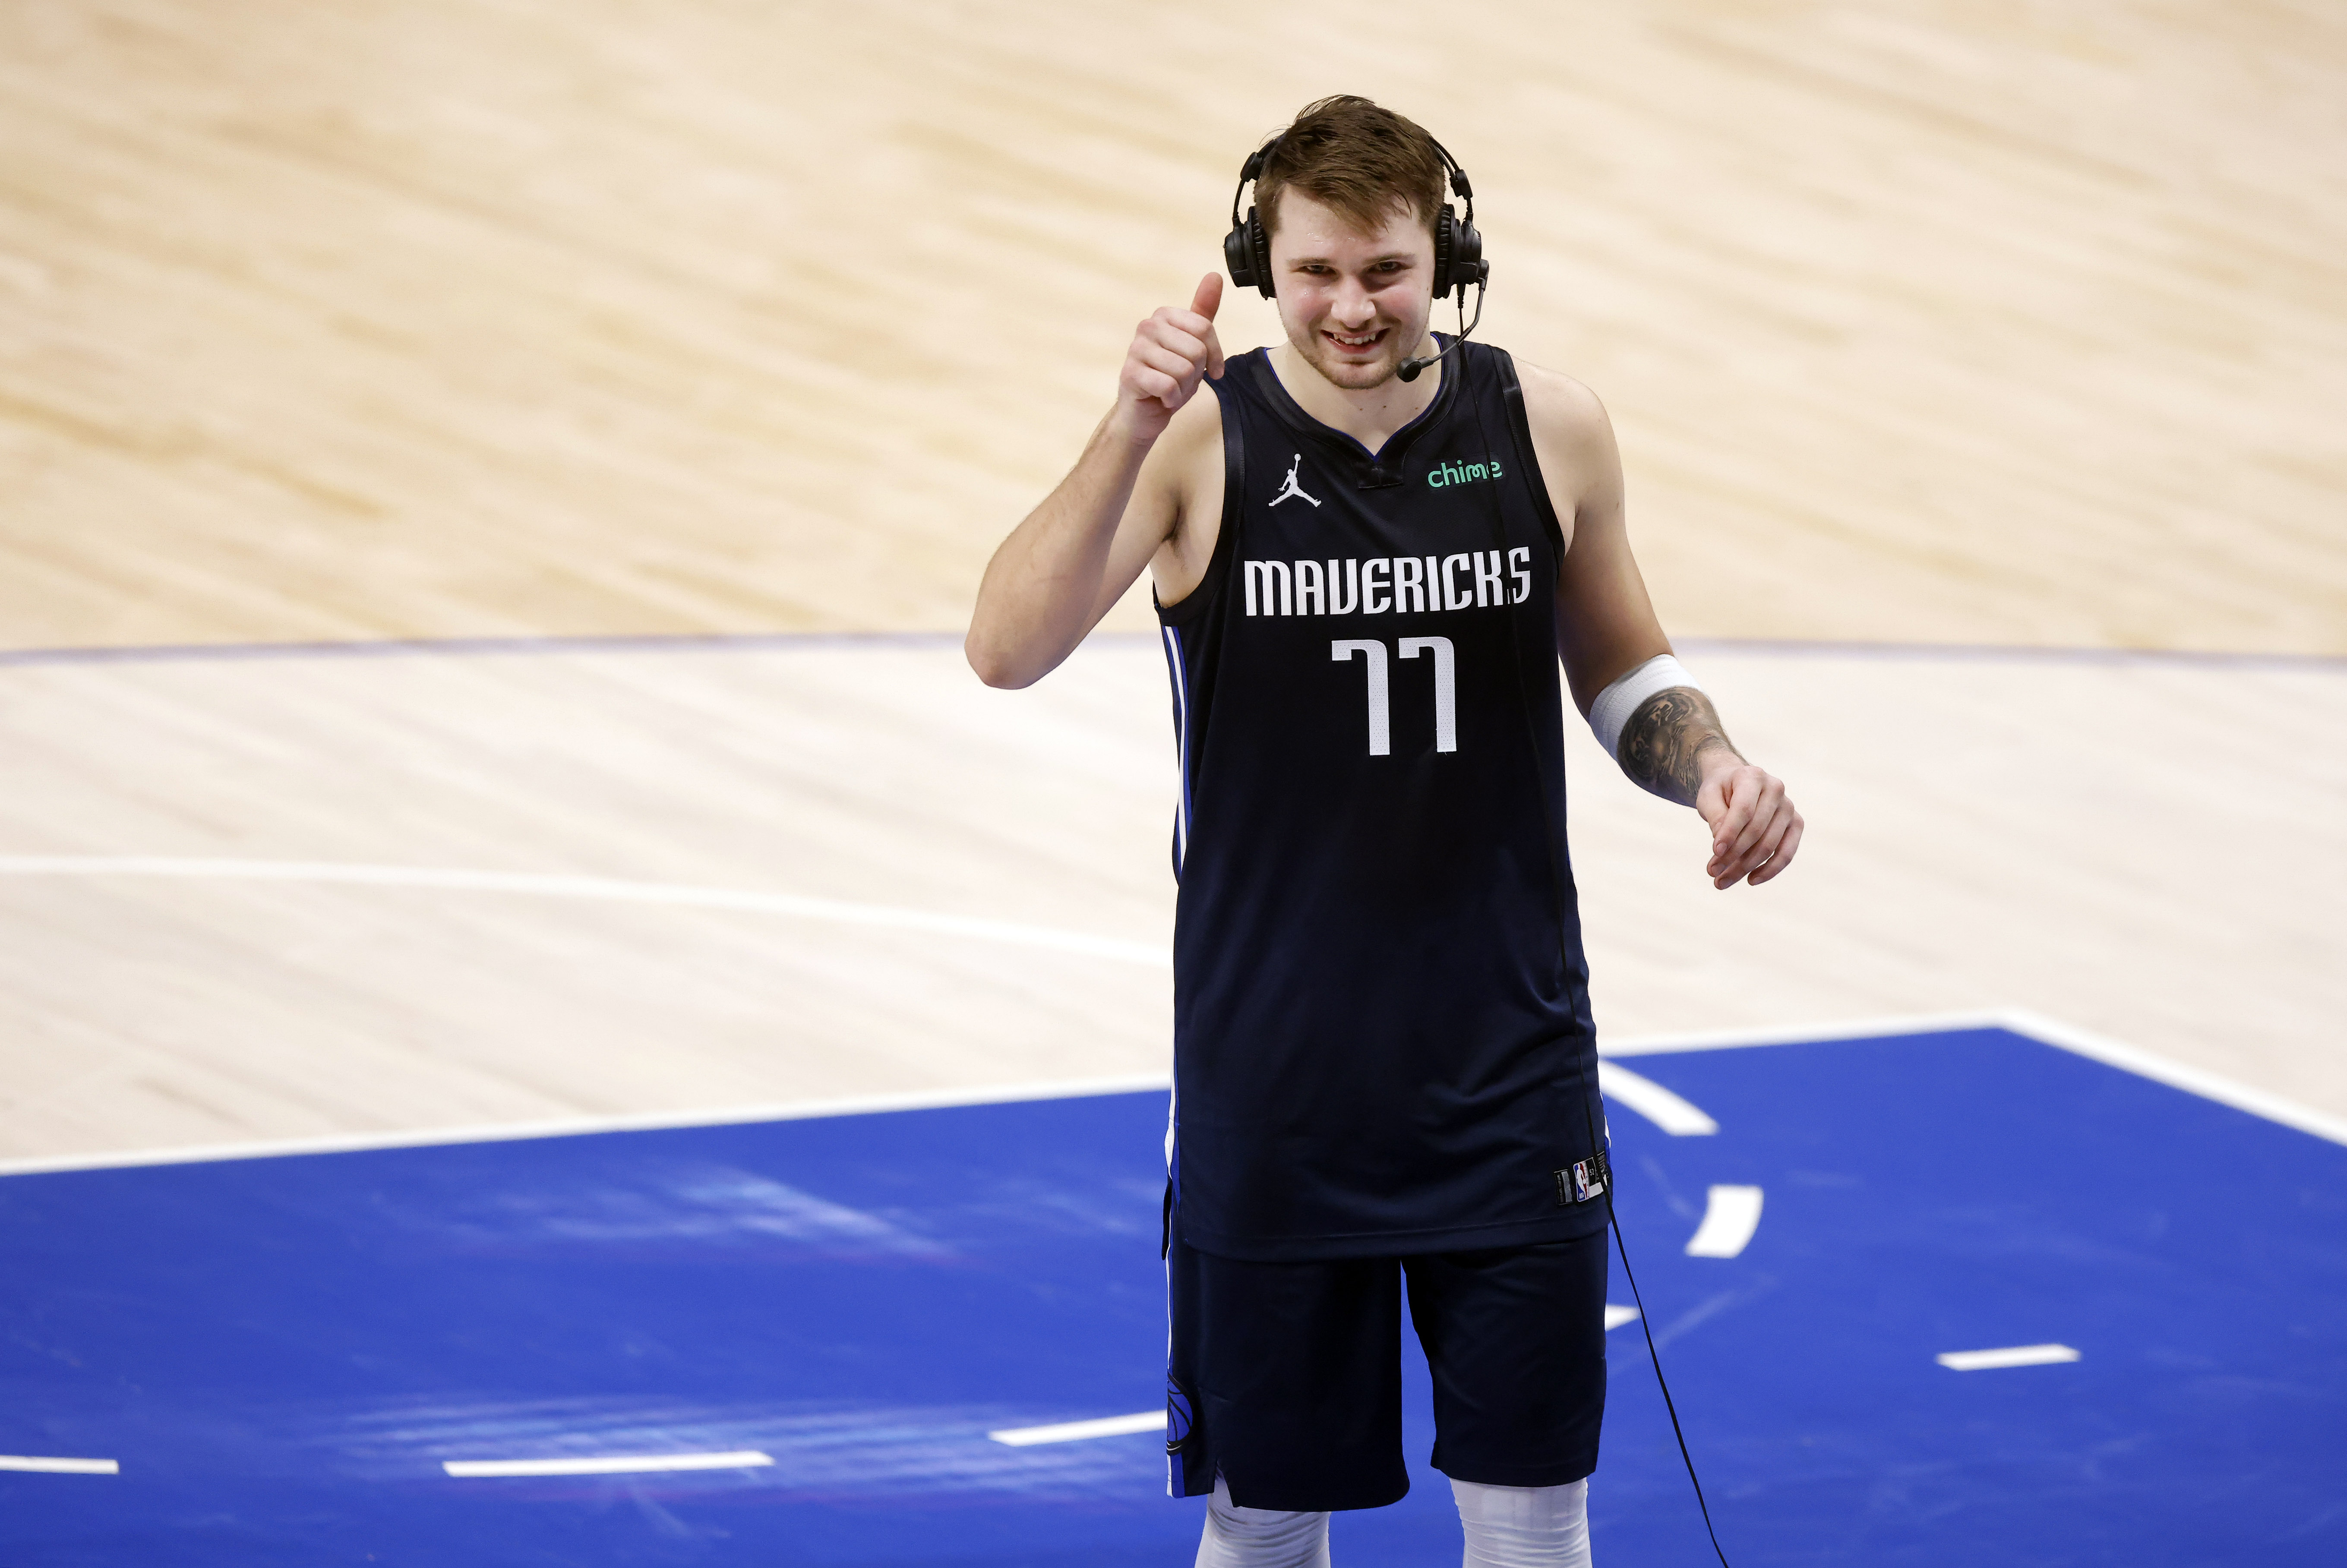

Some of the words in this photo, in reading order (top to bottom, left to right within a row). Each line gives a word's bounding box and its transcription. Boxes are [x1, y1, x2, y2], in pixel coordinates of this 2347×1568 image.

[1428, 460, 1503, 488] chime
[1245, 546, 1531, 616] MAVERICKS
[1332, 637, 1457, 756] 77
[1589, 1168, 1595, 1176] 52
